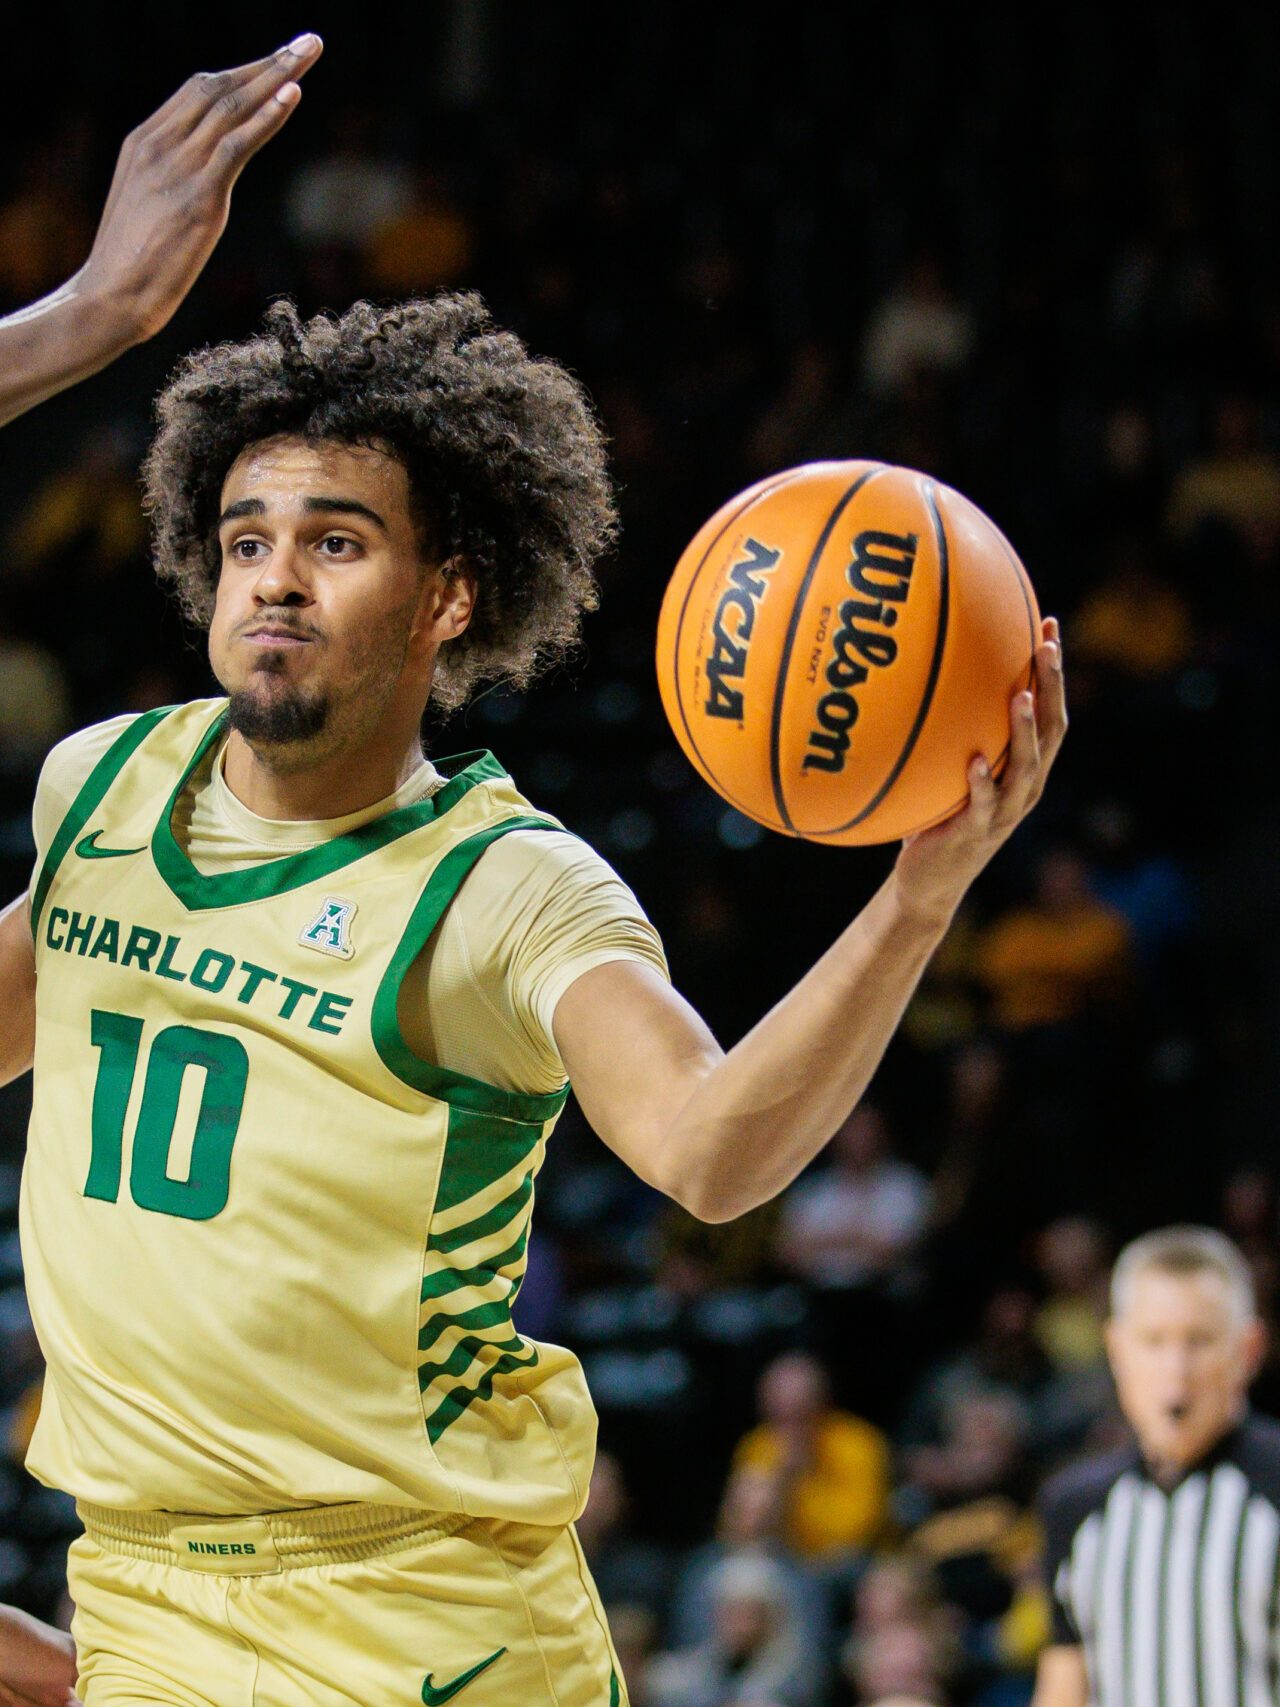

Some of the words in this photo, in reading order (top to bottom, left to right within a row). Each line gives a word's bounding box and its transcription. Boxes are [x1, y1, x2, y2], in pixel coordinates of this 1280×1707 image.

[705, 537, 782, 720] NCAA
[803, 529, 919, 773] Wilson
[807, 648, 822, 685] NXT
[816, 606, 831, 642] EVO
[46, 907, 354, 1036] CHARLOTTE
[82, 1008, 250, 1221] 10
[187, 1541, 257, 1555] NINERS
